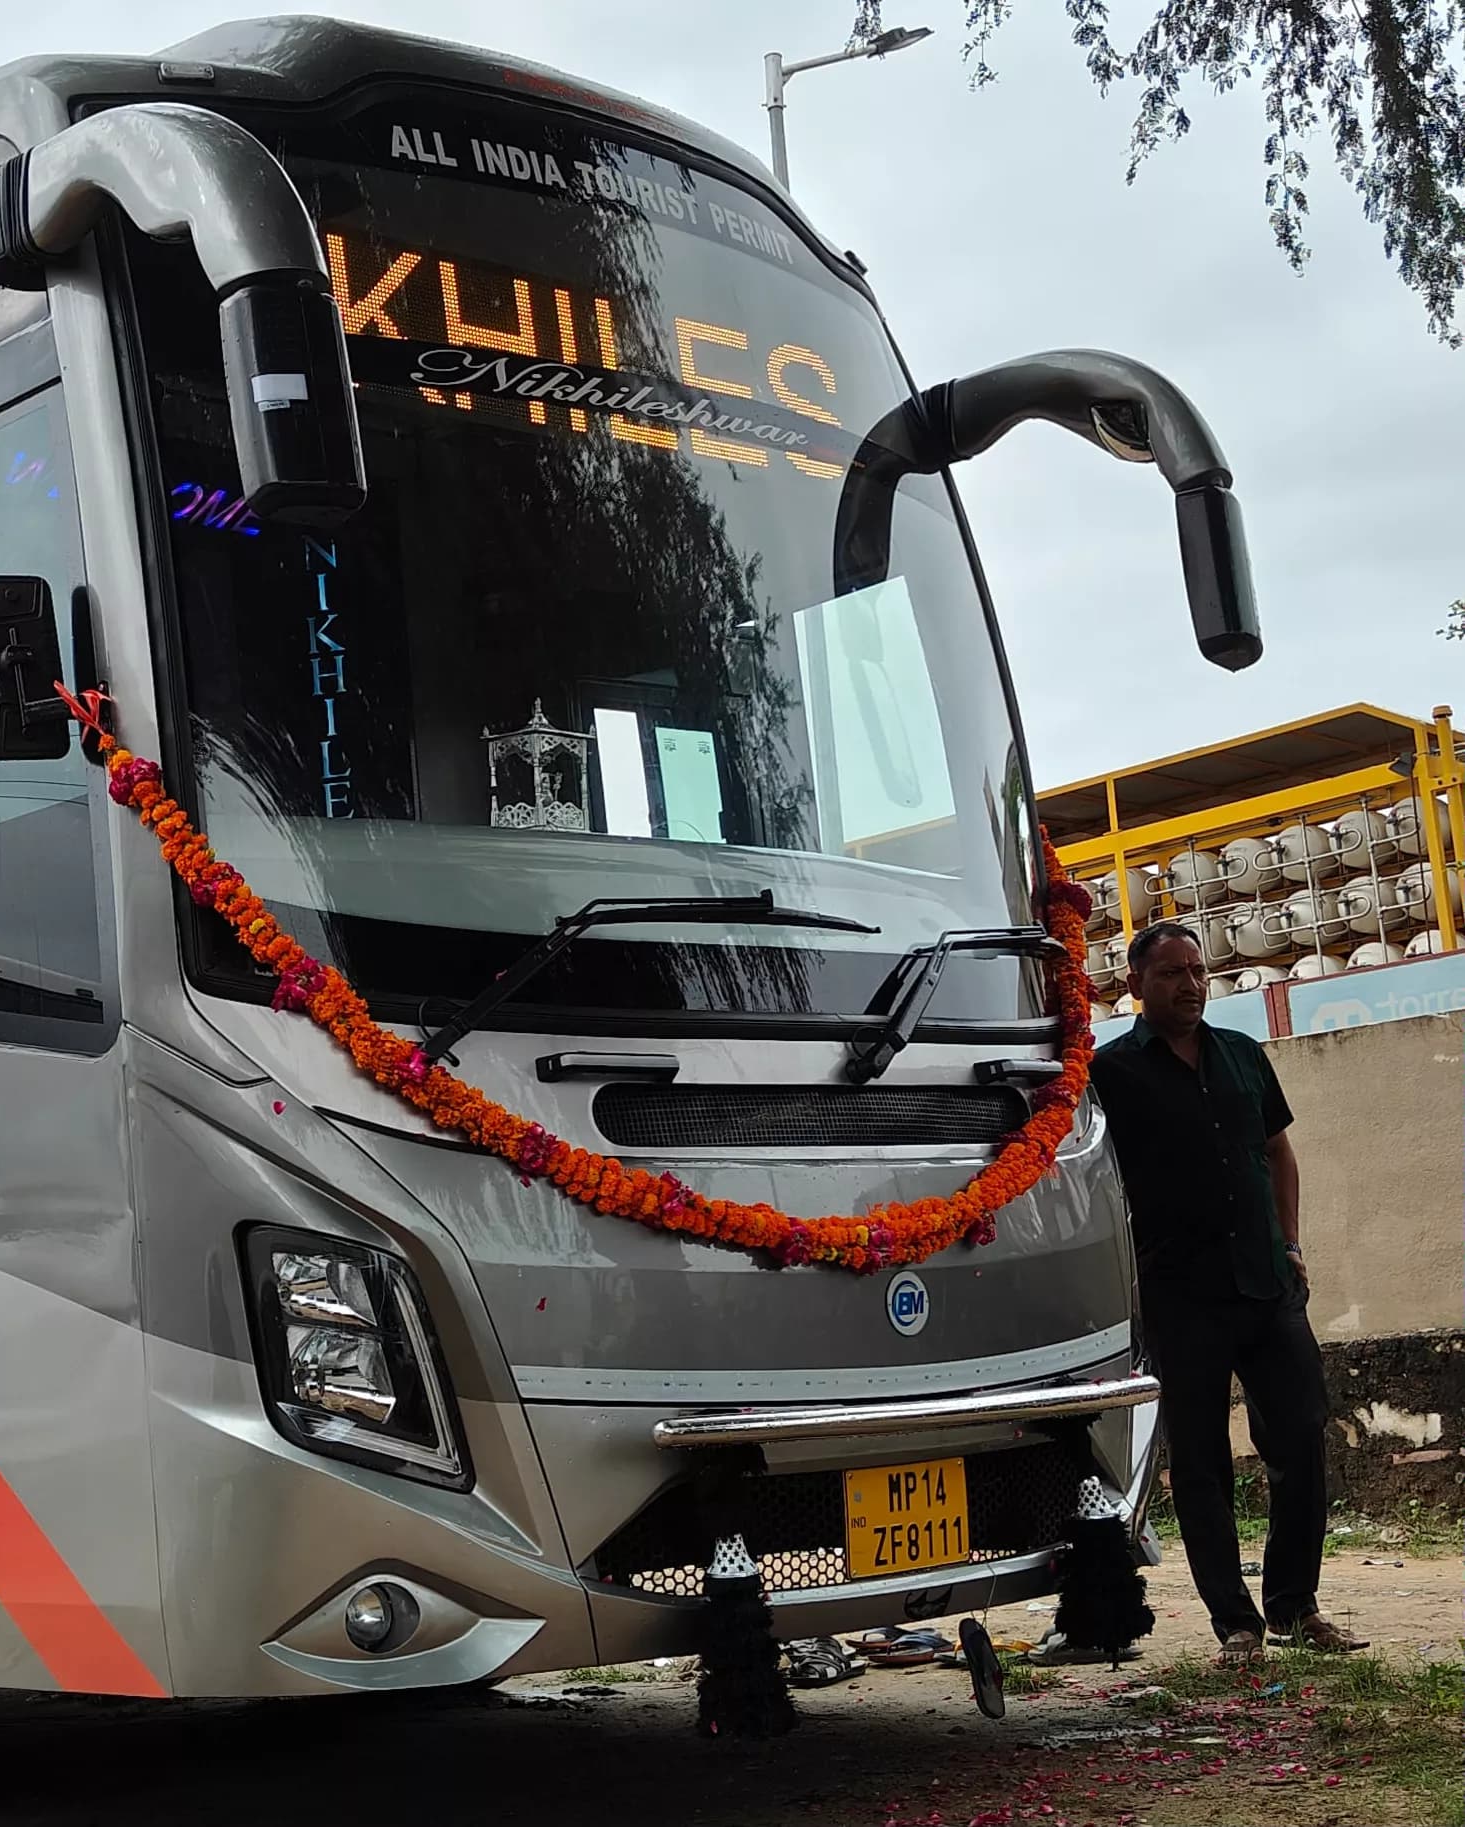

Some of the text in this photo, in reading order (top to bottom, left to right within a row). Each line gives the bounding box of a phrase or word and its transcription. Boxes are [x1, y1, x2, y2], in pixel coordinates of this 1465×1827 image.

[391, 124, 793, 265] ALL INDIA TOURIST PERMIT
[410, 348, 809, 446] Nikhileshwar
[888, 1467, 946, 1512] MP14
[851, 1516, 866, 1528] IND
[873, 1515, 962, 1567] ZF8111
